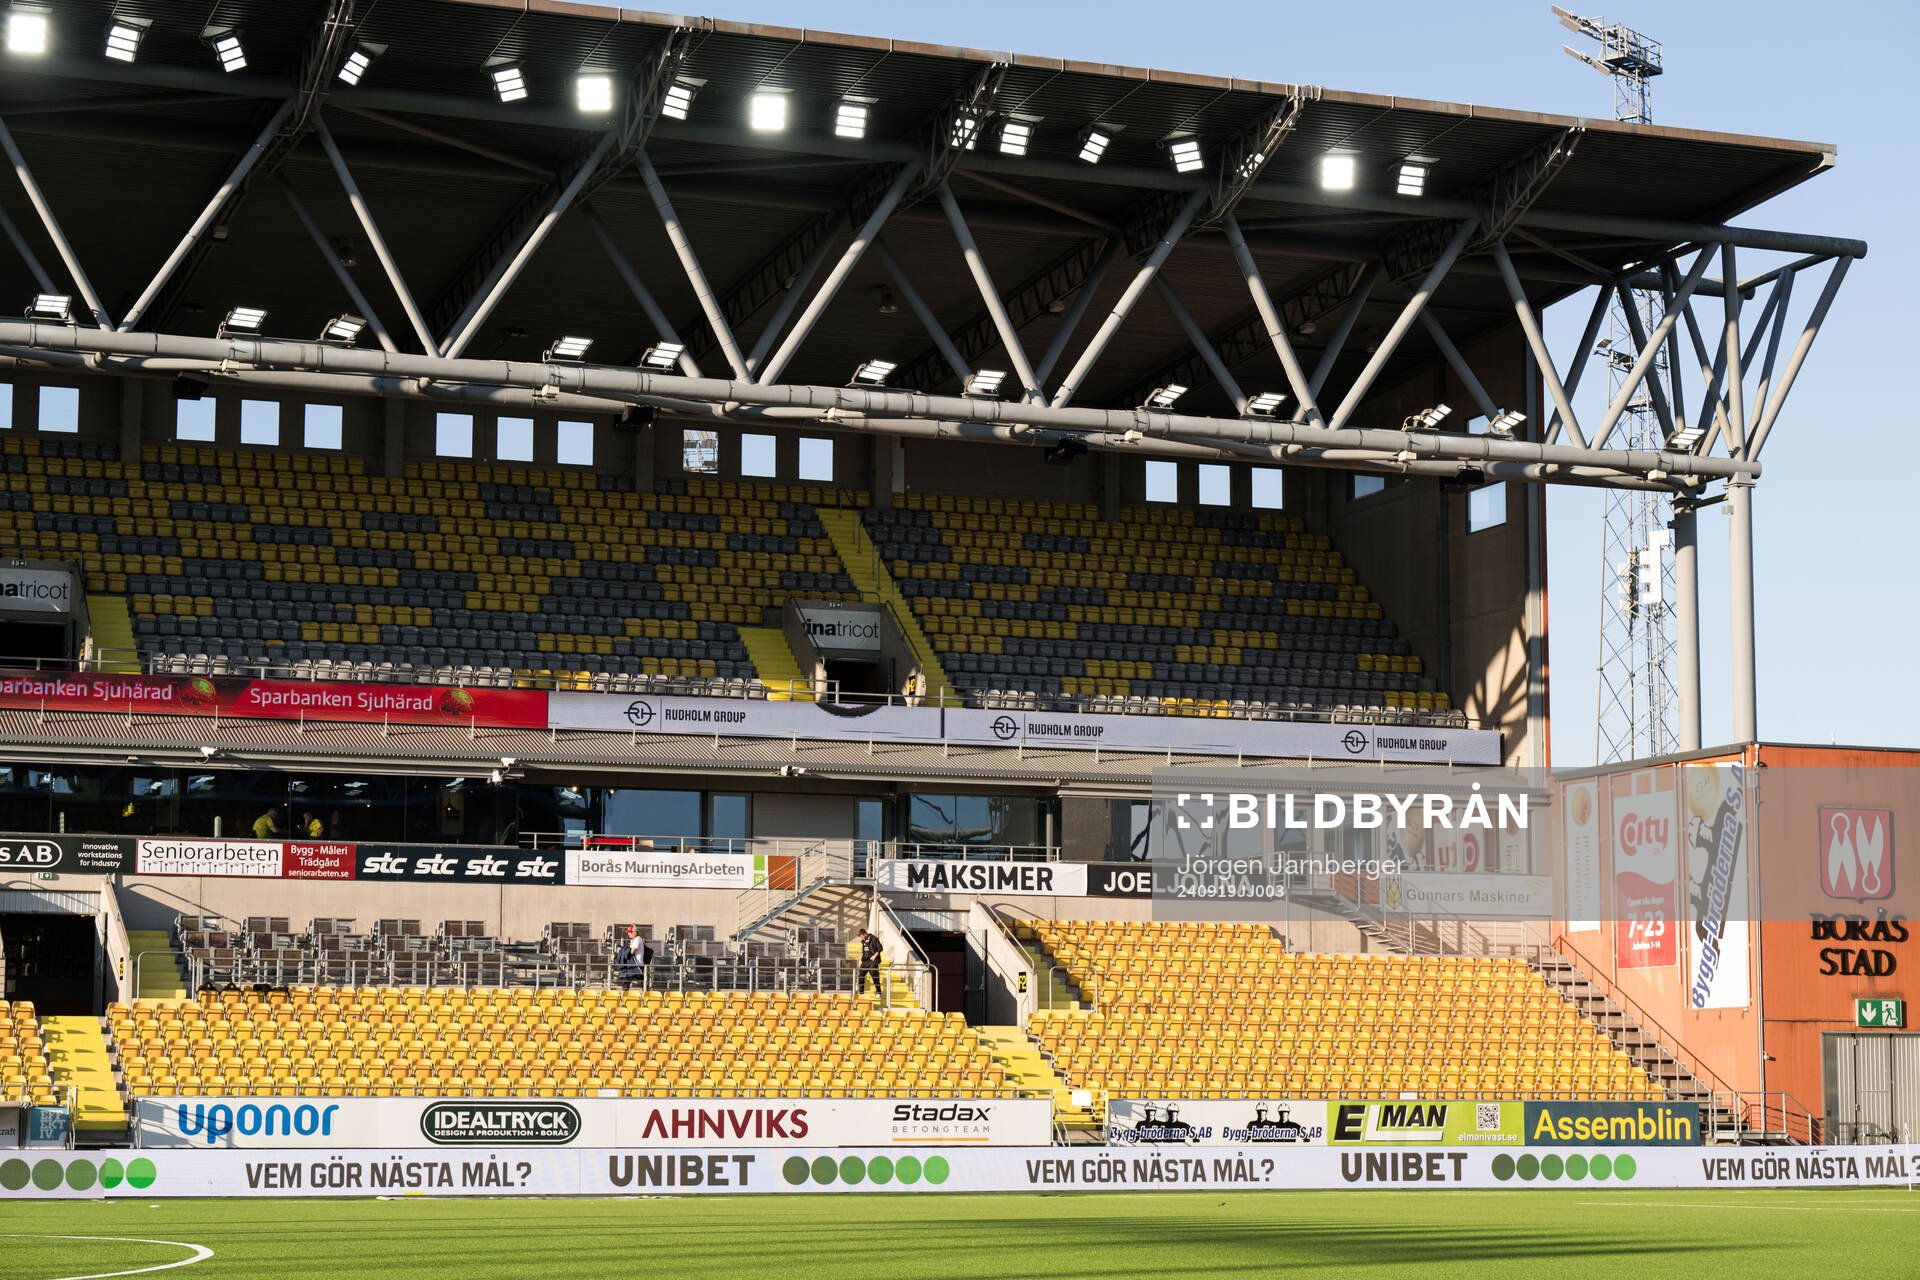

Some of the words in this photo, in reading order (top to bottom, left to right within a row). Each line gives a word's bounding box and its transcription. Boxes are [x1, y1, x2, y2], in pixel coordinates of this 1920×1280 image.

[0, 580, 68, 599] atricot
[803, 618, 879, 638] inatricot
[0, 678, 87, 697] arbanken
[93, 680, 172, 701] Sjuhärad
[250, 687, 352, 710] Sparbanken
[357, 692, 433, 712] Sjuhärad
[665, 708, 711, 722] RUDHOLM
[714, 710, 746, 723] GROUP
[1028, 723, 1071, 736] RUDHOLM
[1074, 725, 1104, 737] GROUP
[1377, 737, 1417, 750] RUDHOLM
[1419, 739, 1447, 751] GROUP
[16, 845, 53, 863] AB
[78, 851, 123, 859] workstations
[82, 842, 119, 851] innovative
[142, 841, 279, 861] Seniorarbeten
[291, 844, 314, 857] Bygg
[320, 845, 348, 855] Måleri
[92, 860, 120, 869] industry
[299, 857, 340, 869] Trädgård
[363, 852, 407, 874] stc
[414, 853, 459, 875] stc
[465, 854, 509, 876] stc
[515, 856, 559, 878] stc
[581, 858, 622, 873] Borås
[625, 860, 745, 878] MurningsArbeten
[288, 869, 349, 878] seniorarbeten.se
[907, 863, 1053, 892] MAKSIMER
[1406, 888, 1464, 901] Gunnars
[1469, 890, 1531, 904] Maskiner
[1628, 910, 1665, 938] 7-23
[1810, 907, 1909, 942] BORÅS
[1820, 948, 1897, 976] STAD
[434, 1111, 569, 1129] IDEALTRYCK
[892, 1103, 992, 1122] Stadax
[0, 1127, 16, 1136] raft
[40, 1120, 66, 1129] EKT
[178, 1104, 339, 1144] uponor
[434, 1129, 467, 1137] DESIGN
[540, 1129, 569, 1137] BORÅS
[641, 1108, 808, 1139] AHNVIKS
[892, 1125, 990, 1133] BETONGTEAM
[1533, 1107, 1691, 1141] Assemblin
[1110, 1126, 1186, 1142] Bygg-bröderna
[1222, 1126, 1297, 1141] Bygg-bröderna
[1458, 1133, 1519, 1142] elmanivast.se
[245, 1162, 302, 1188] VEM
[310, 1155, 362, 1188] GÖR
[370, 1155, 454, 1188] NÄSTA
[462, 1154, 531, 1187] MÅL?
[609, 1155, 755, 1187] UNIBET
[1026, 1159, 1075, 1184] VEM
[1082, 1153, 1127, 1183] GÖR
[1133, 1153, 1207, 1183] NÄSTA
[1213, 1152, 1275, 1182] MÅL?
[1341, 1152, 1468, 1182] UNIBET
[1702, 1157, 1745, 1181] VEM
[1751, 1152, 1790, 1180] GÖR
[1796, 1151, 1860, 1179] NÄSTA
